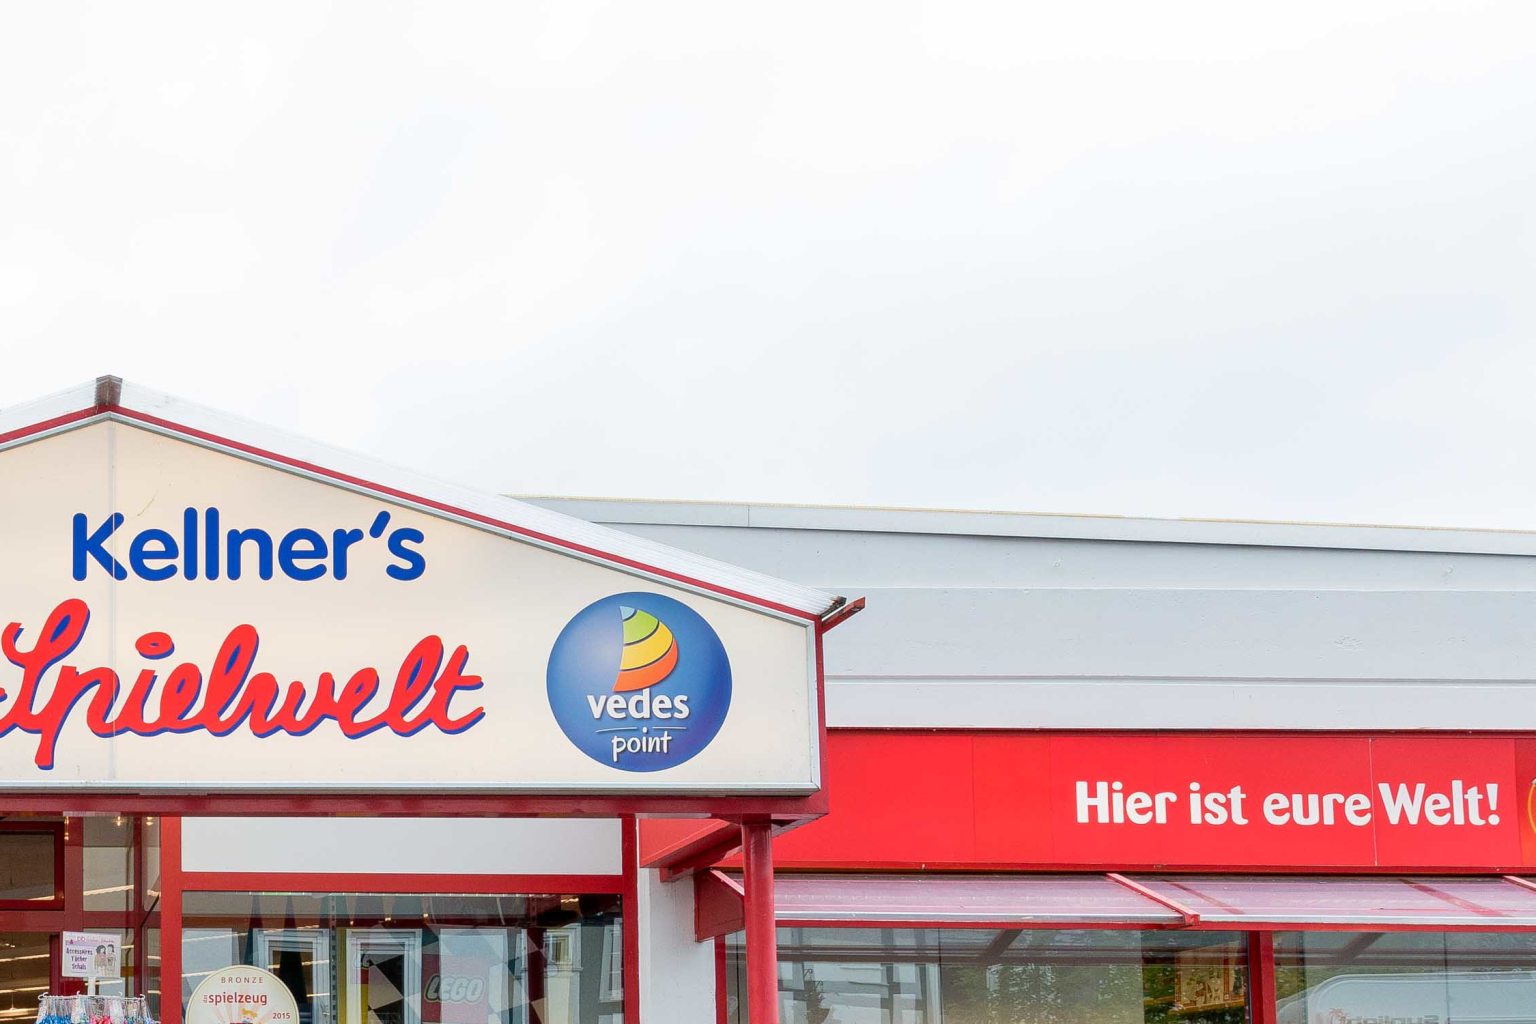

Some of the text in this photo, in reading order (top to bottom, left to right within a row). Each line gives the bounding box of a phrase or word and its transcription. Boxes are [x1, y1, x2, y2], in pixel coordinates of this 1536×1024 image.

[71, 506, 426, 582] Kellner's
[587, 688, 691, 721] vedes
[610, 726, 673, 763] point
[1075, 779, 1501, 827] Hier ist eure Welt!
[221, 976, 264, 984] BRONZE
[424, 974, 487, 1004] LEGO
[208, 991, 268, 1006] spielzeug
[272, 1012, 291, 1020] 2015
